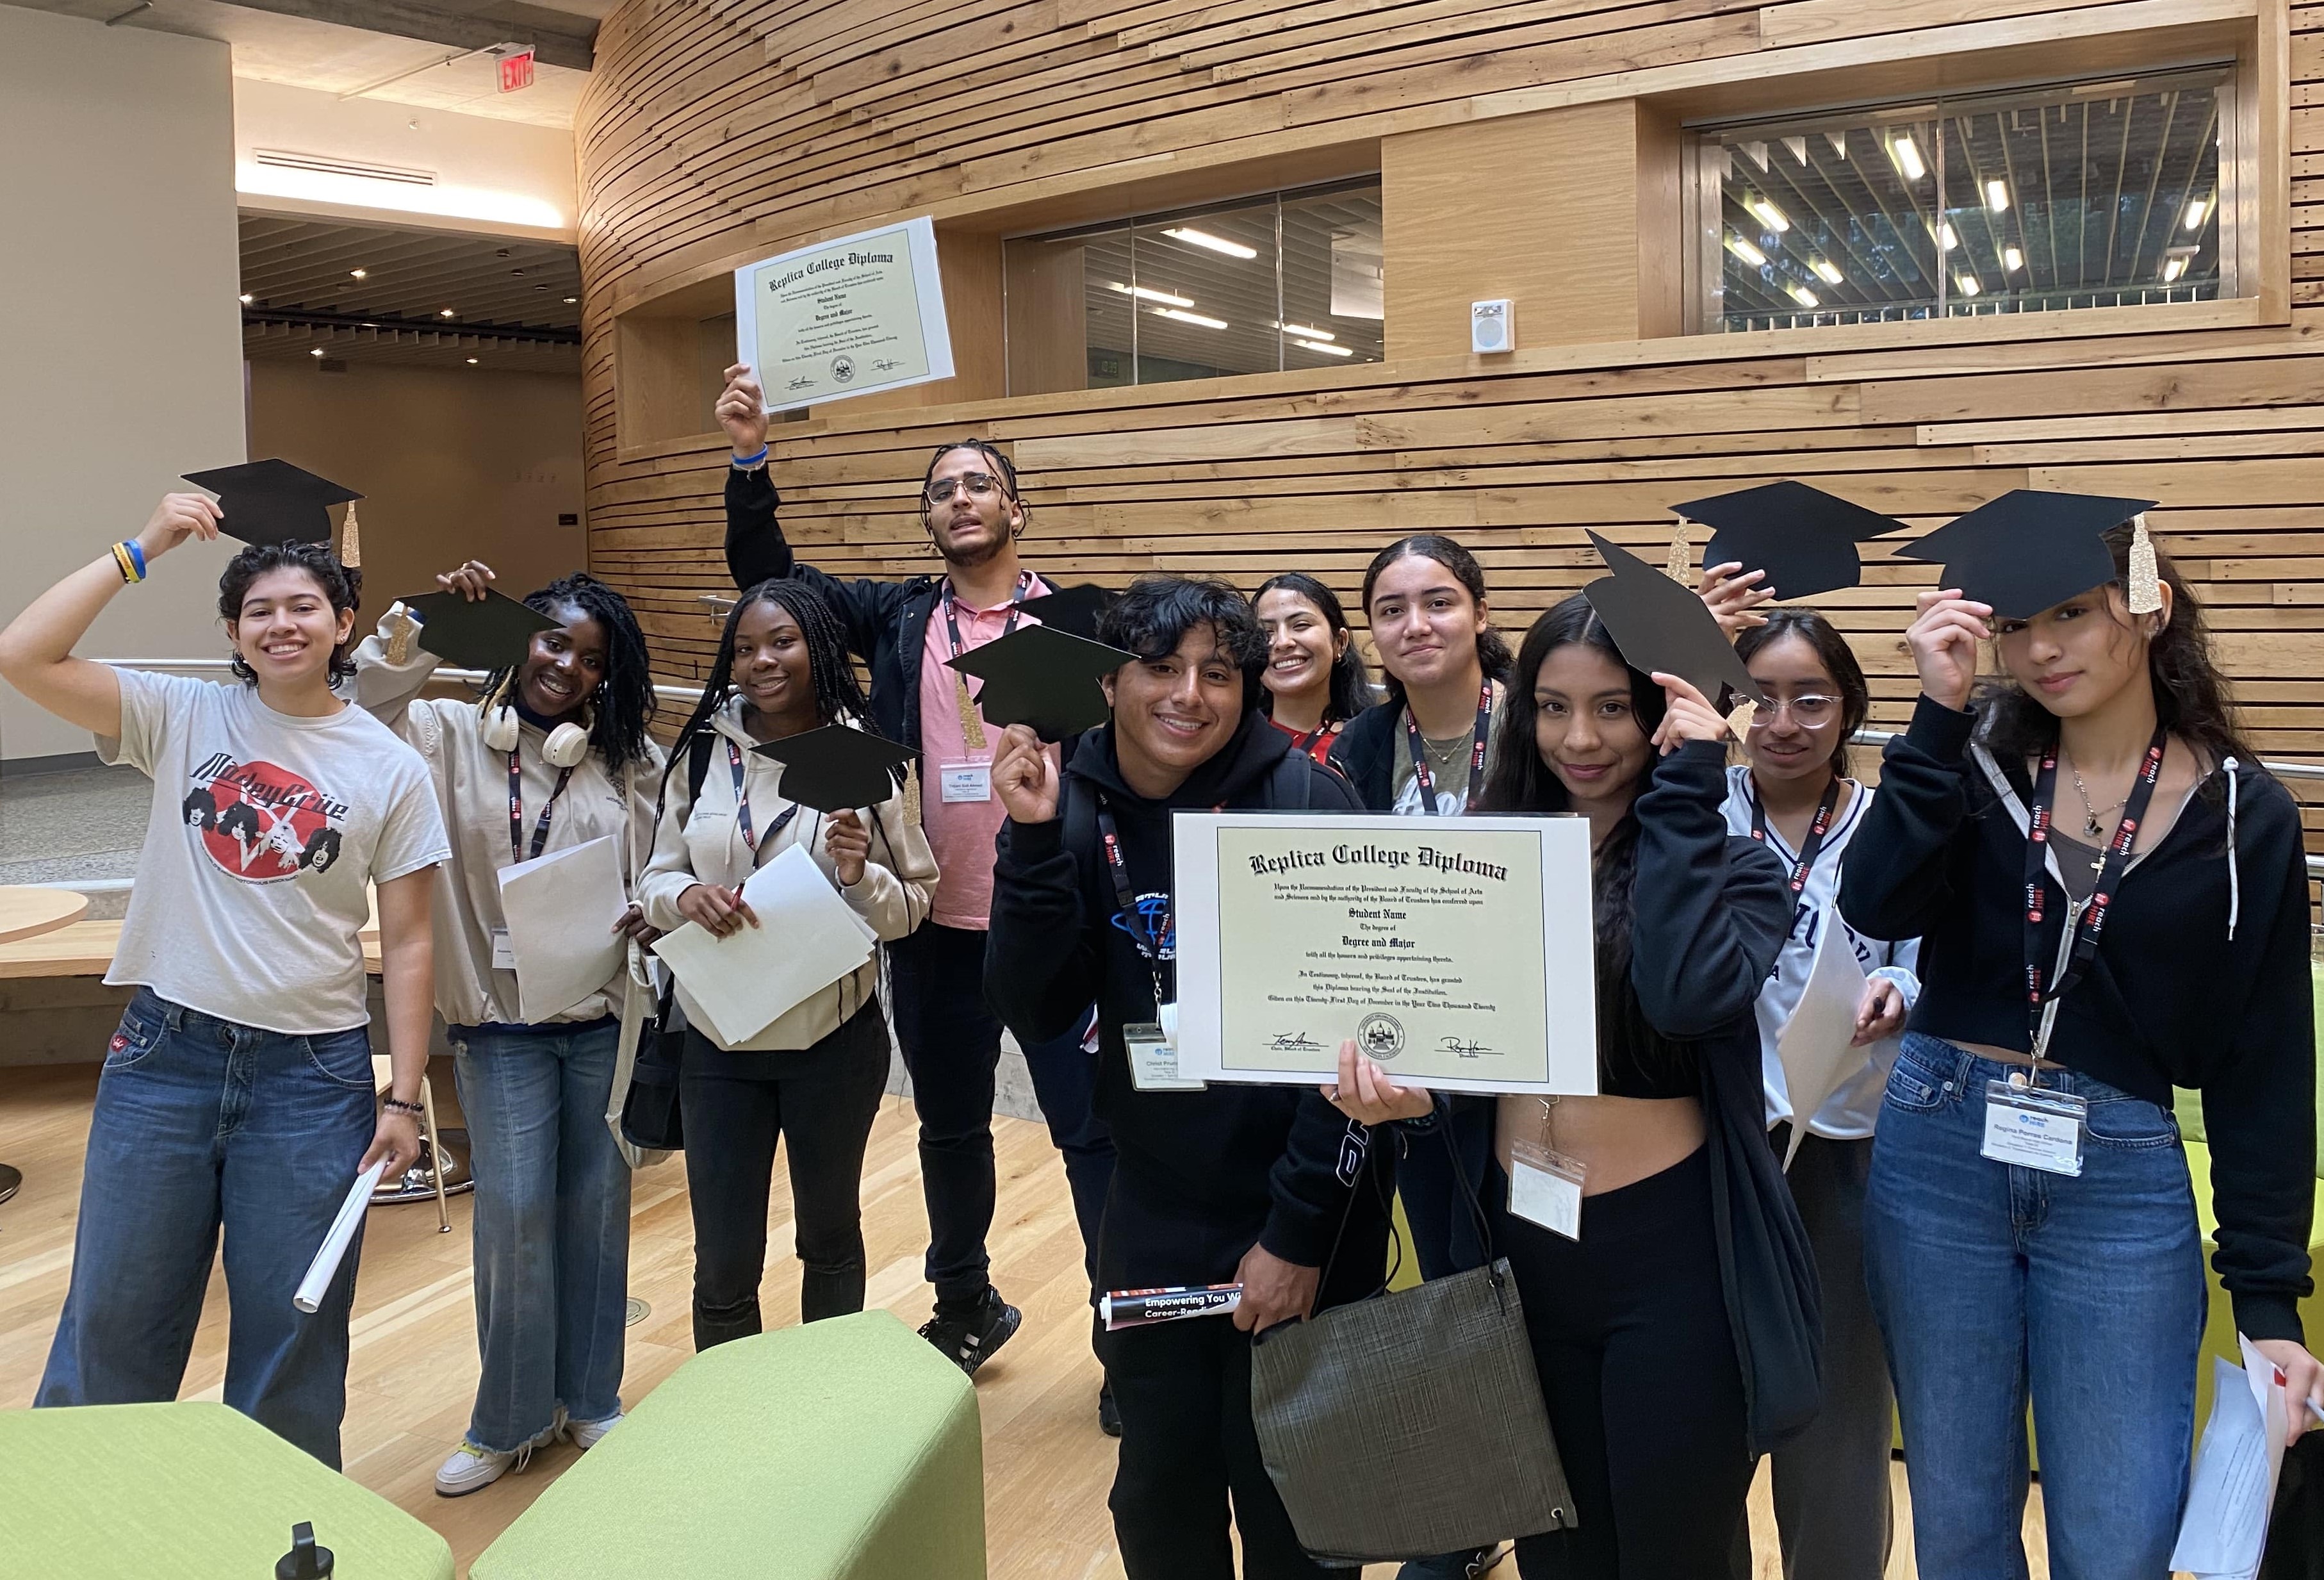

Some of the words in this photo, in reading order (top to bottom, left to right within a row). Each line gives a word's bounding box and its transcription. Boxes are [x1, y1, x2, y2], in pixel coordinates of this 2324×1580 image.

[502, 56, 528, 90] EXIT
[769, 270, 804, 292] Replica
[806, 258, 844, 274] College
[848, 252, 893, 266] Diploma
[2146, 761, 2158, 784] reach
[1815, 806, 1827, 824] reach
[2033, 805, 2043, 828] reach
[2119, 833, 2132, 857] reach
[1113, 845, 1124, 866] reach
[1248, 850, 1326, 876] Replica
[1332, 844, 1411, 868] College
[1418, 846, 1508, 882] Diploma
[1794, 862, 1805, 880] reach
[1361, 885, 1387, 893] President
[1400, 885, 1422, 894] Faculty
[1439, 887, 1459, 895] School
[2026, 884, 2034, 909] reach
[2035, 888, 2044, 909] HIRE
[1348, 907, 1381, 919] Student
[1383, 909, 1407, 919] Name
[2092, 907, 2106, 932] reach
[1159, 914, 1170, 934] reach
[1359, 923, 1371, 931] The
[1342, 935, 1370, 948] Degree
[1371, 937, 1386, 947] and
[1389, 937, 1416, 950] Major
[1298, 970, 1307, 979] In
[1375, 973, 1393, 981] Board
[1430, 976, 1440, 984] has
[2026, 964, 2034, 989] reach
[1325, 983, 1349, 992] Diploma
[1294, 995, 1304, 1003] this
[1346, 997, 1359, 1006] Day
[1402, 1000, 1410, 1008] the
[1412, 1000, 1425, 1008] Year
[1443, 1001, 1472, 1010] Thousand
[1145, 1295, 1204, 1307] Empowering
[1207, 1292, 1225, 1303] You
